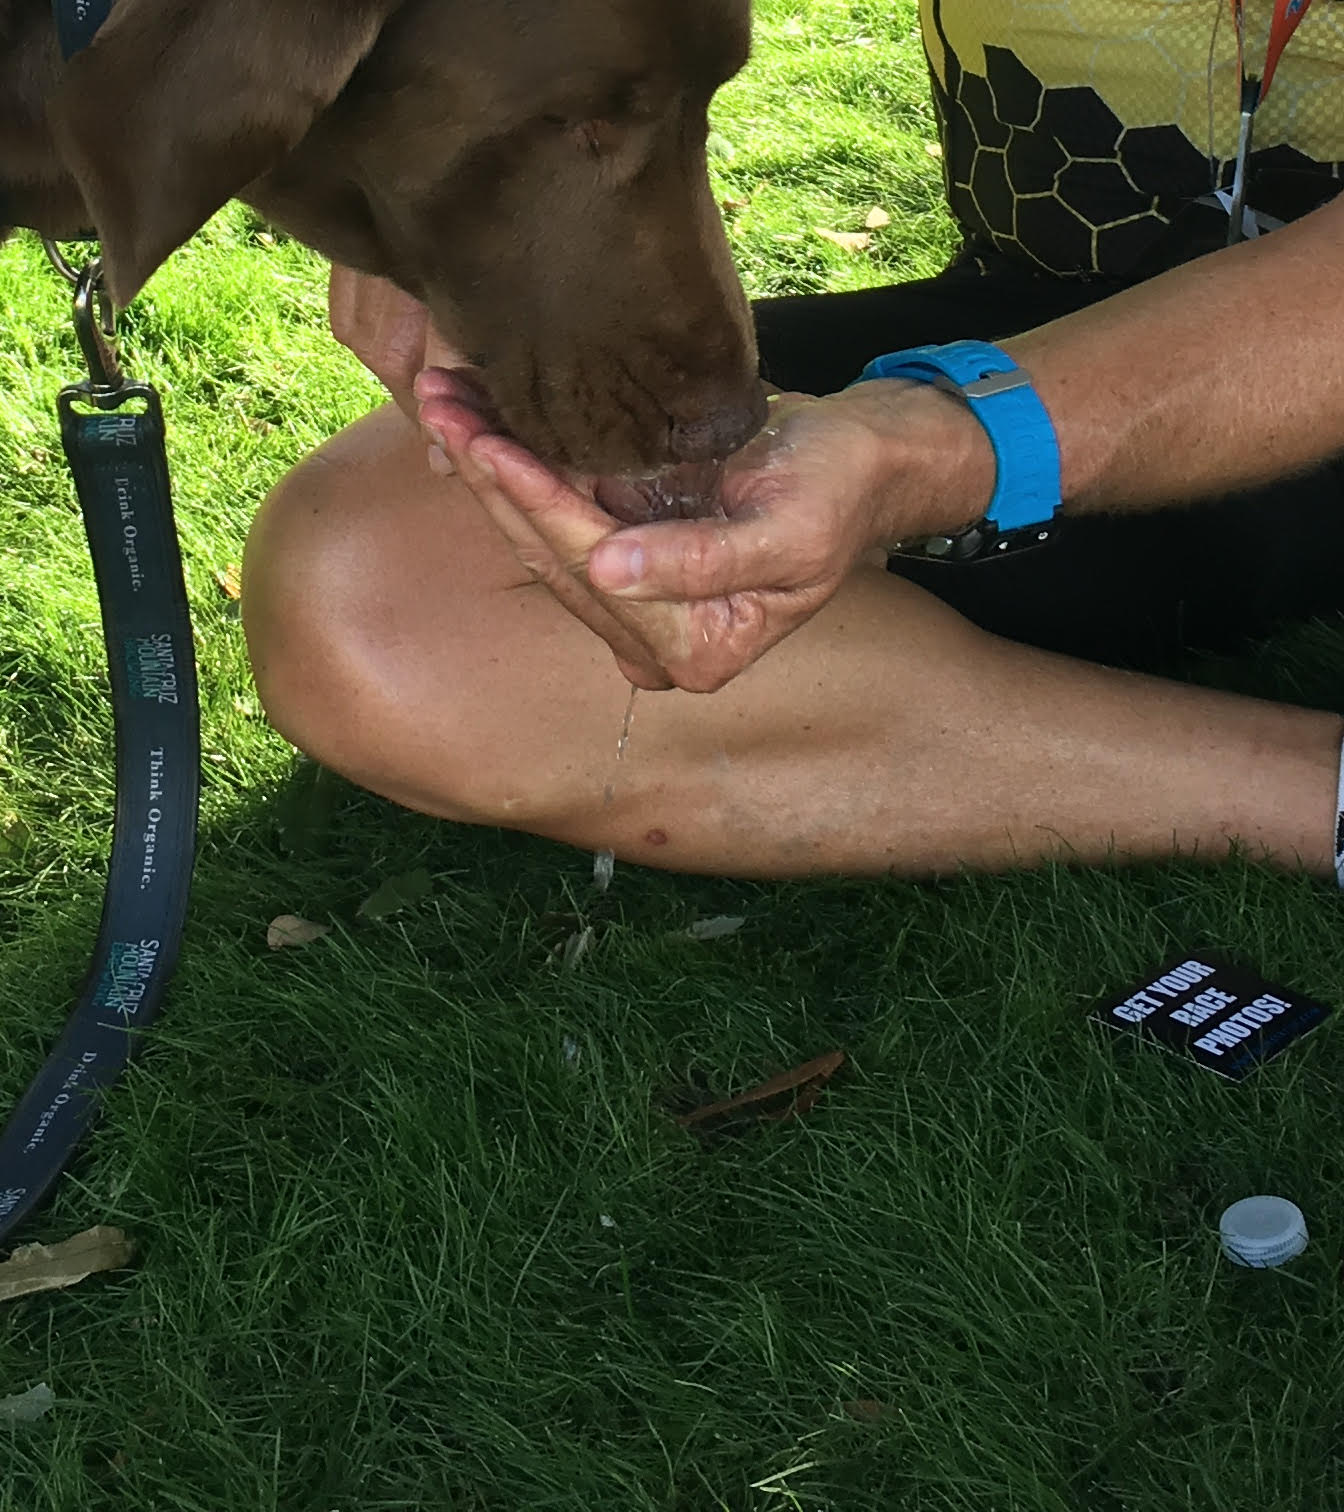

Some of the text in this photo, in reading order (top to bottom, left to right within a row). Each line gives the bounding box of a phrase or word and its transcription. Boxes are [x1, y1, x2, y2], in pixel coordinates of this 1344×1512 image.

[141, 747, 164, 890] Think Organic.
[137, 939, 160, 979] SANTA
[1112, 960, 1217, 1023] GET YOUR
[1169, 986, 1239, 1028] RACE
[1193, 993, 1293, 1056] PHOTOS!
